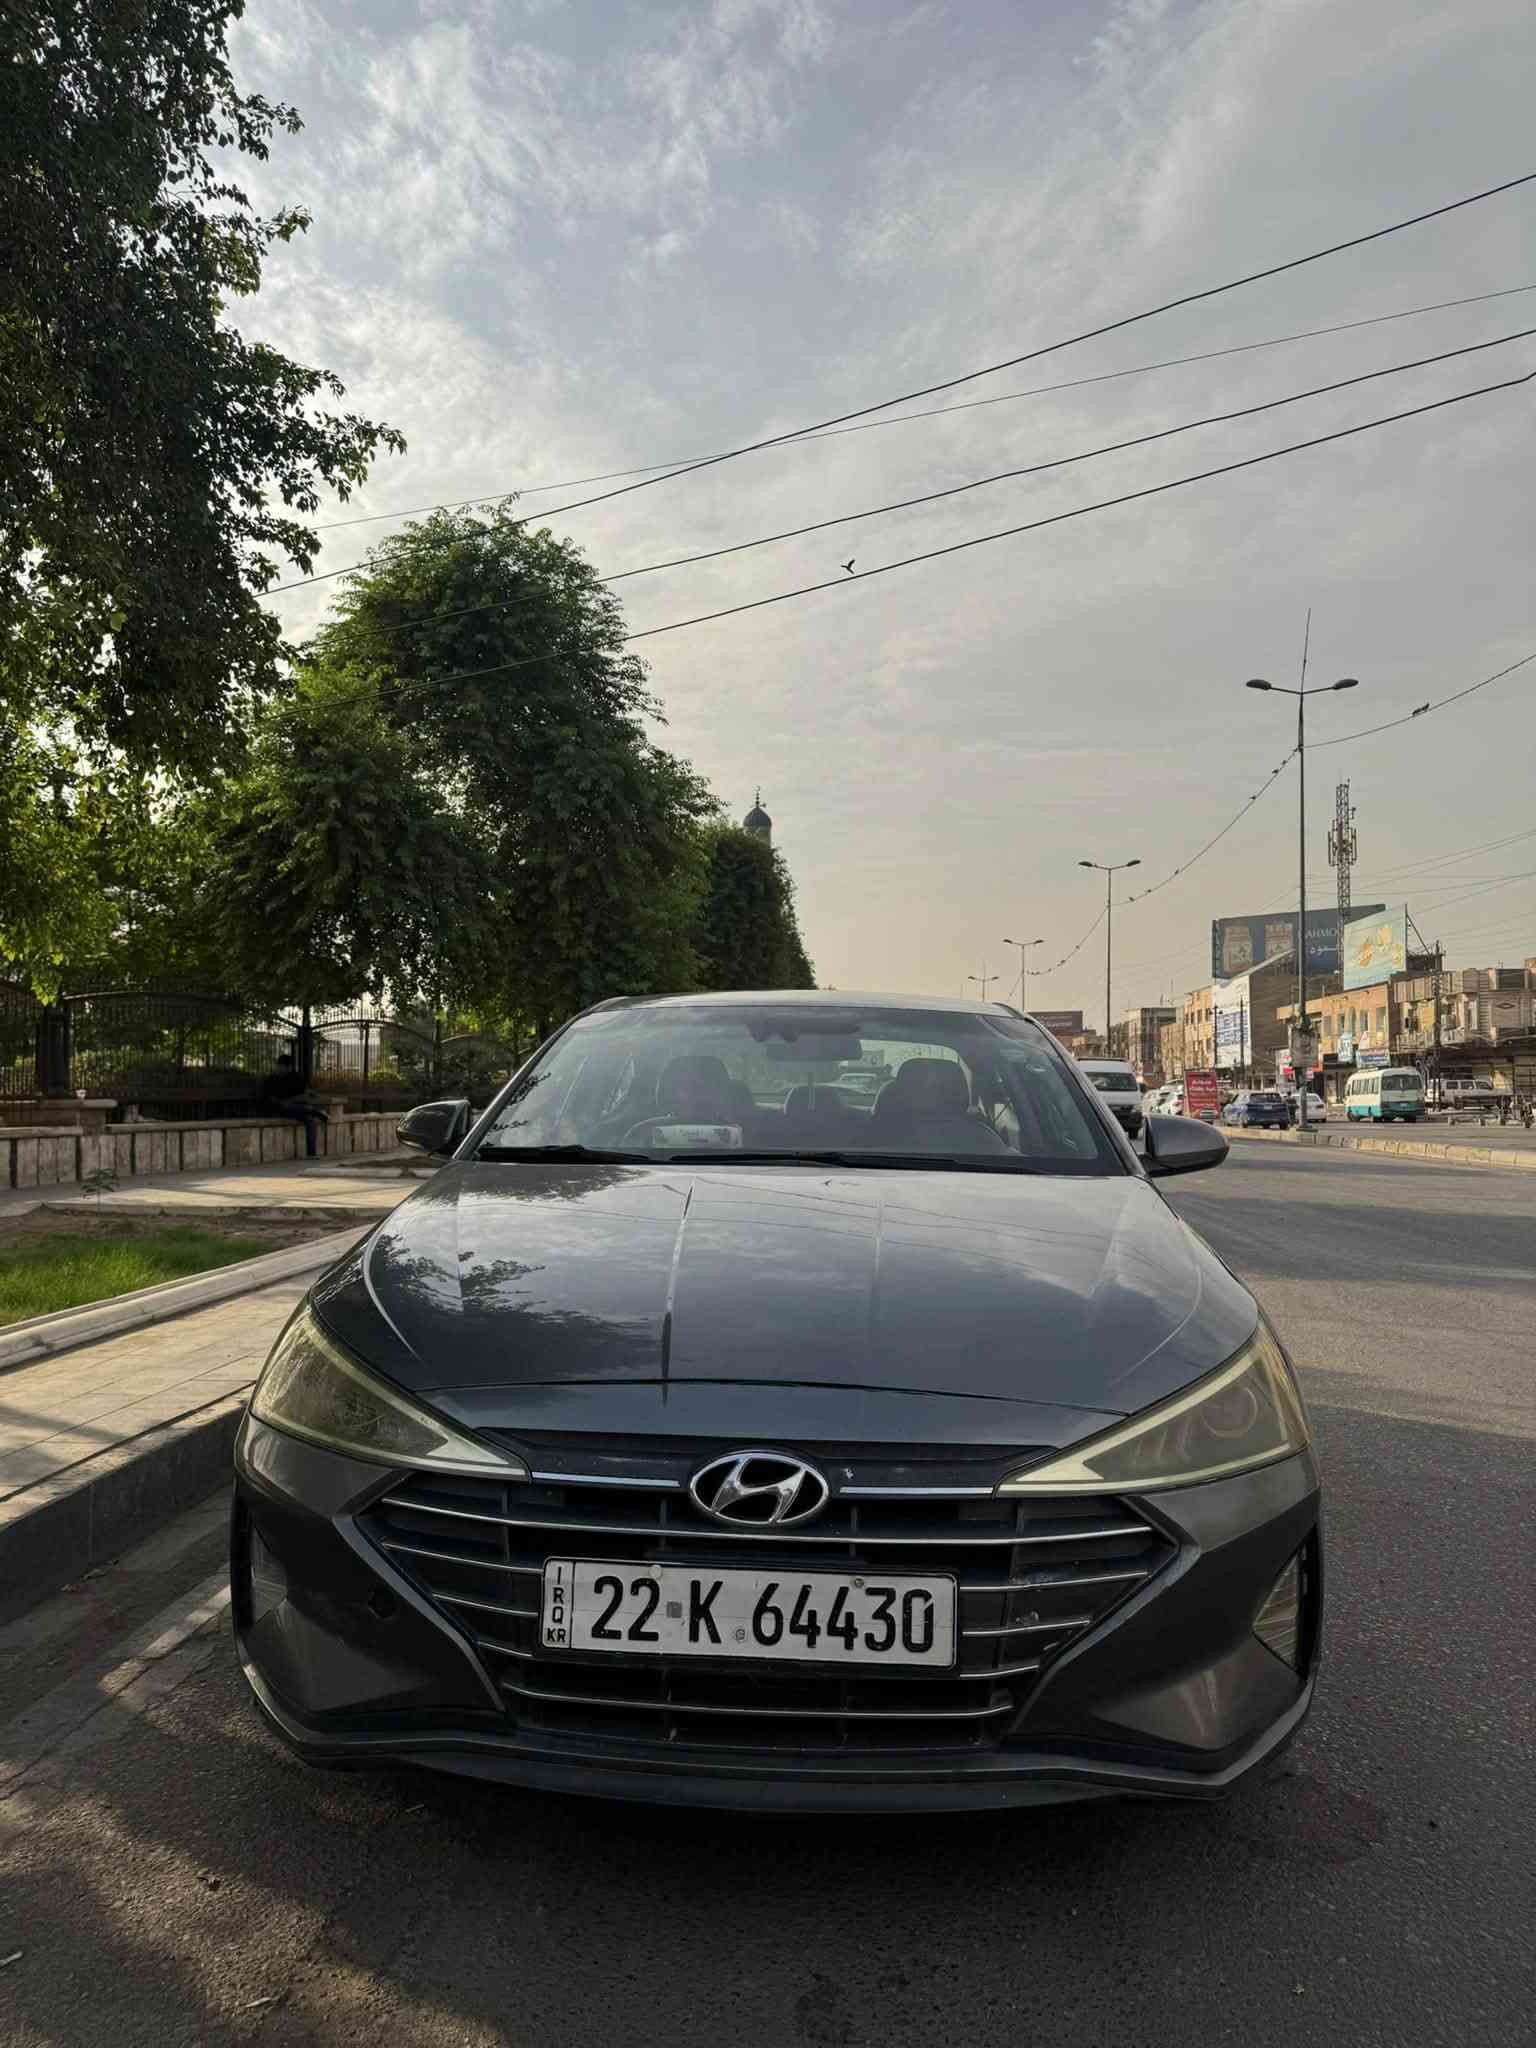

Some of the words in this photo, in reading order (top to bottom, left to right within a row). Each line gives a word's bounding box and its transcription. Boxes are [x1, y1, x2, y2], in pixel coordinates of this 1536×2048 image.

[547, 1627, 566, 1643] KR
[591, 1575, 661, 1641] 22
[688, 1580, 724, 1644] K
[752, 1582, 935, 1654] 64430
